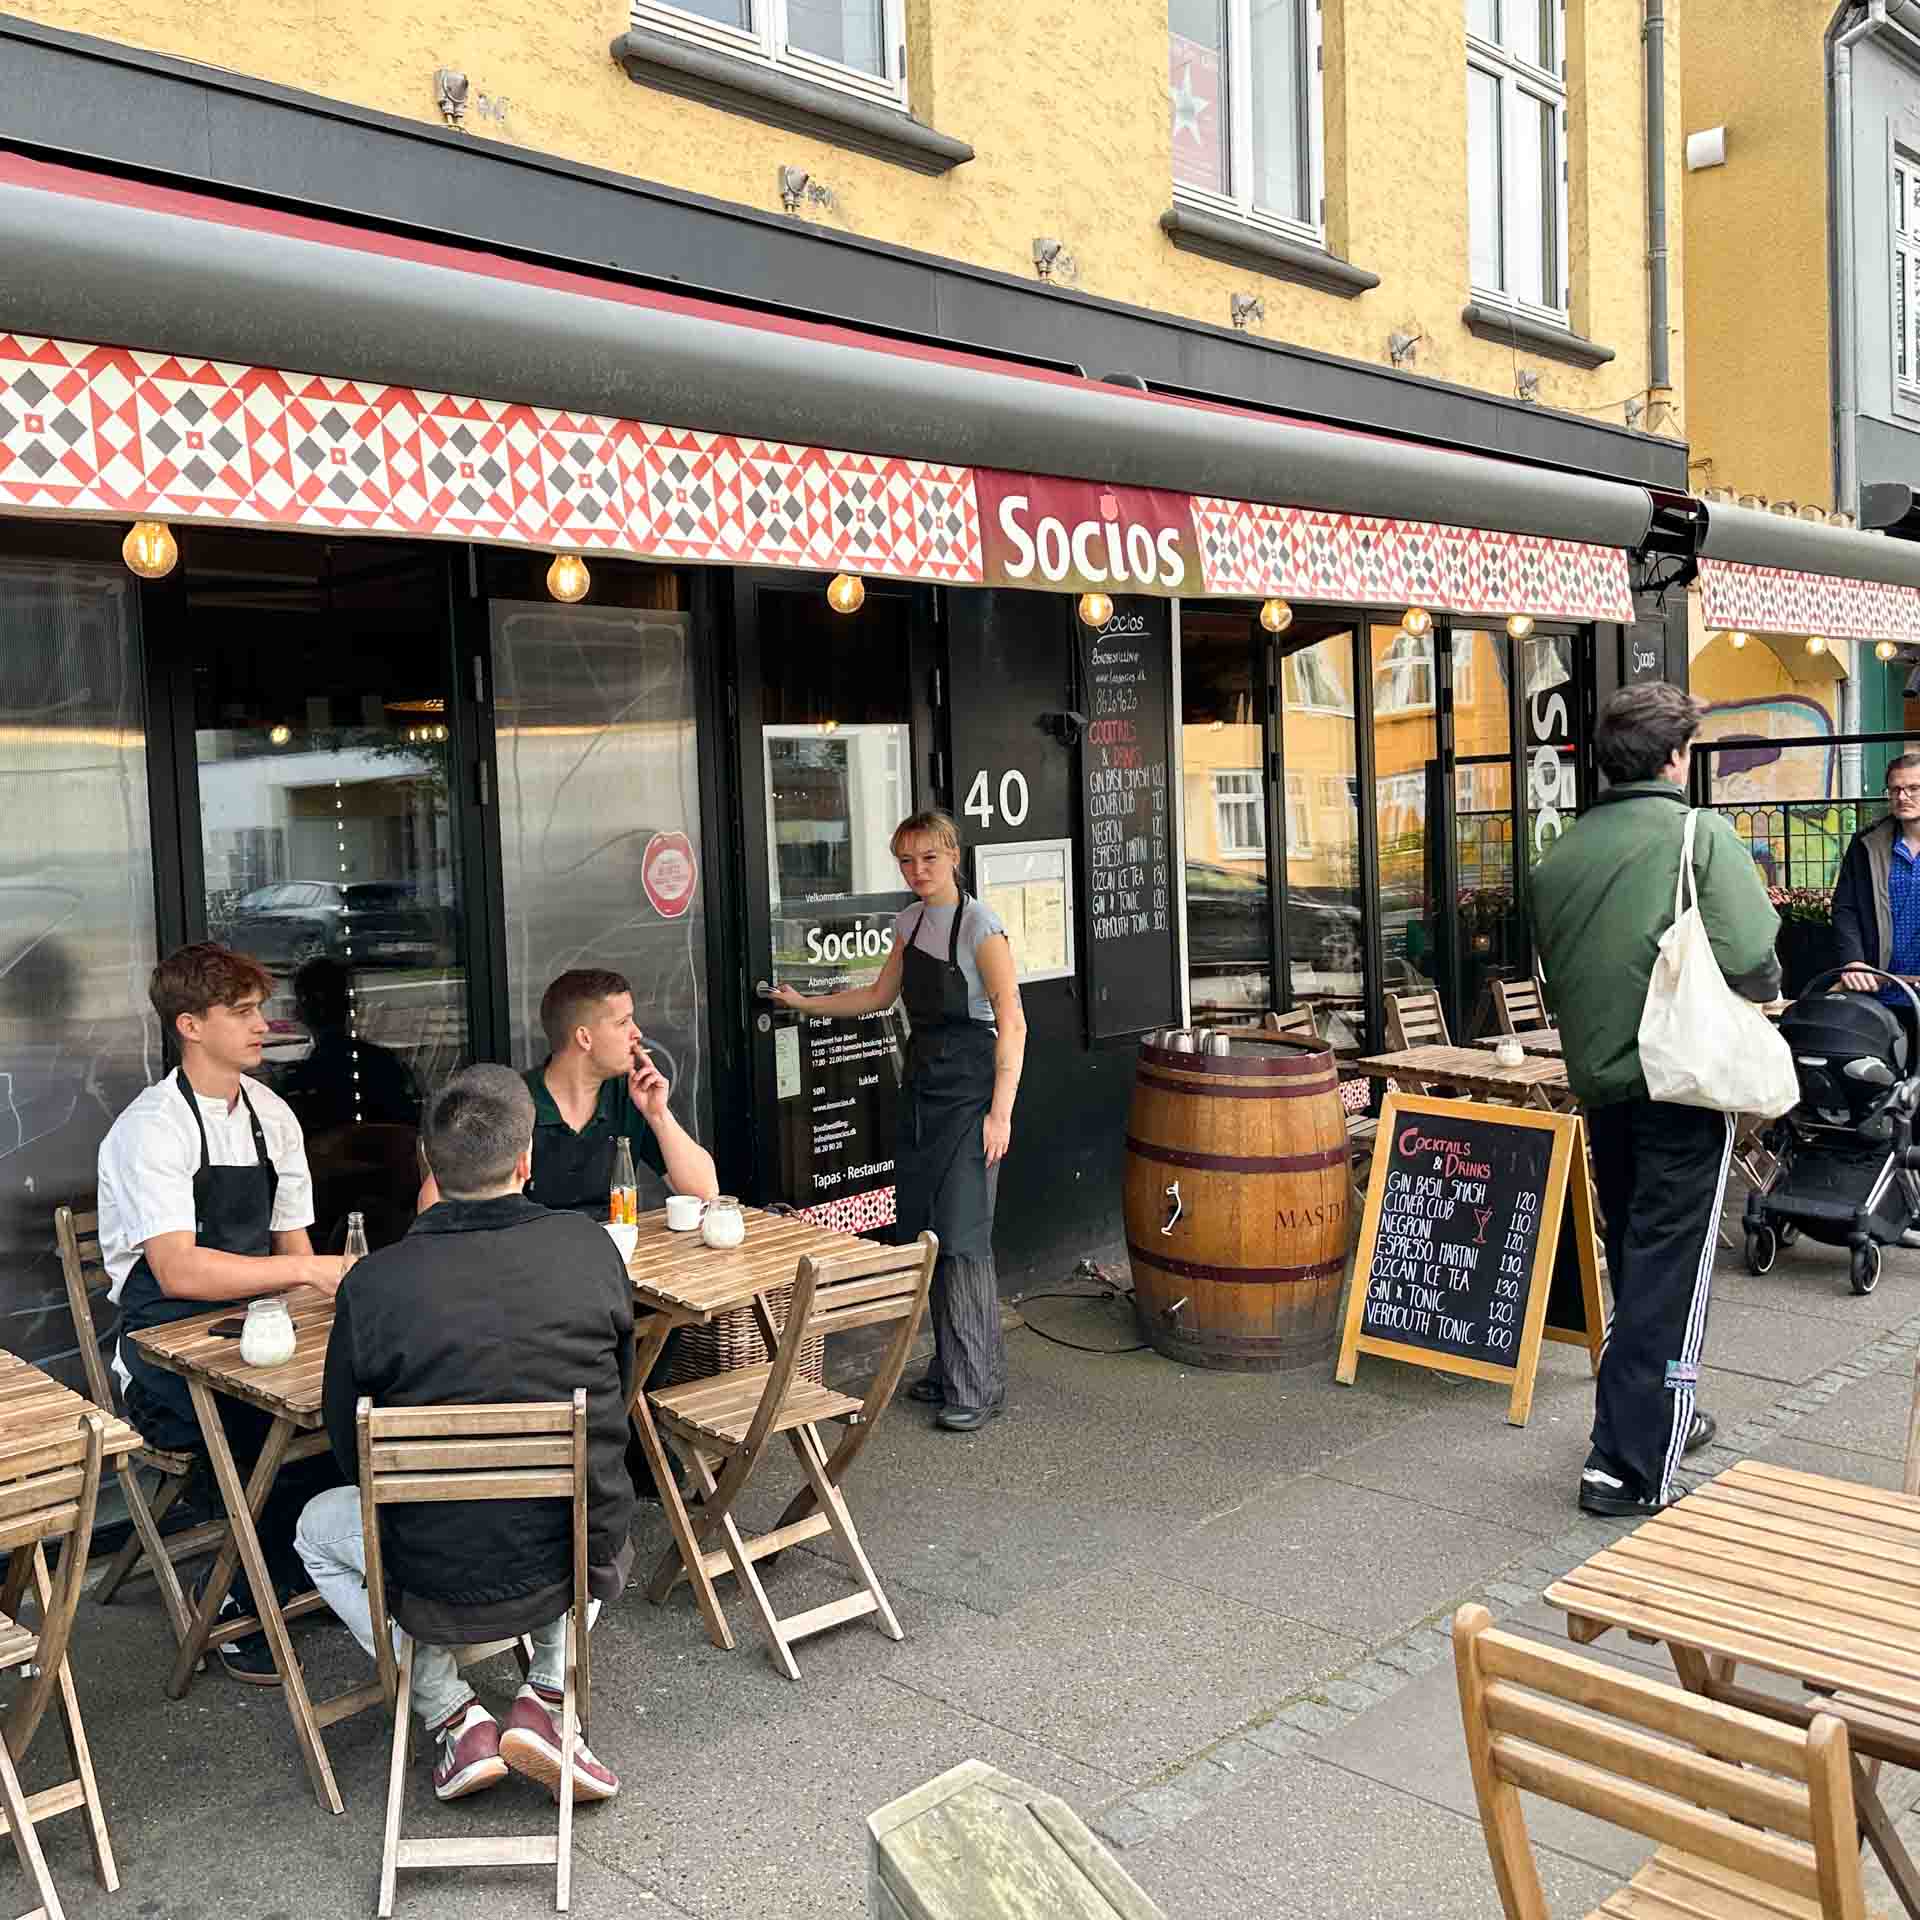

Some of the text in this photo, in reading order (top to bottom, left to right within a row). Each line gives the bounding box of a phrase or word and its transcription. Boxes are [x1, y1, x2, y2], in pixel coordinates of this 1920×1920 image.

[999, 494, 1185, 587] Socios
[1090, 770, 1104, 793] GIN
[964, 770, 1028, 828] 40
[1090, 793, 1118, 817] CLOVER
[1130, 866, 1144, 888] TEA
[1092, 894, 1106, 915] GIN
[1117, 891, 1141, 915] TONIC
[807, 920, 894, 964] Socios
[812, 1159, 896, 1189] Tapas Restauran
[1433, 1156, 1442, 1170] &
[1388, 1171, 1412, 1193] GIN
[1416, 1176, 1442, 1199] BASIL
[1448, 1180, 1486, 1205] SMASH
[1384, 1192, 1424, 1217] CLOVER
[1426, 1198, 1456, 1220] CLUB
[1380, 1213, 1432, 1240] NEGRONI
[1376, 1234, 1434, 1262] ESPRESSO
[1438, 1242, 1479, 1271] MARTINI
[1423, 1262, 1442, 1286] ICE
[1448, 1267, 1470, 1292] TEA
[1368, 1278, 1391, 1302] GIN
[1408, 1284, 1446, 1312] TONIC
[1366, 1300, 1431, 1336] VERMOUTH
[1436, 1315, 1476, 1345] TONIC
